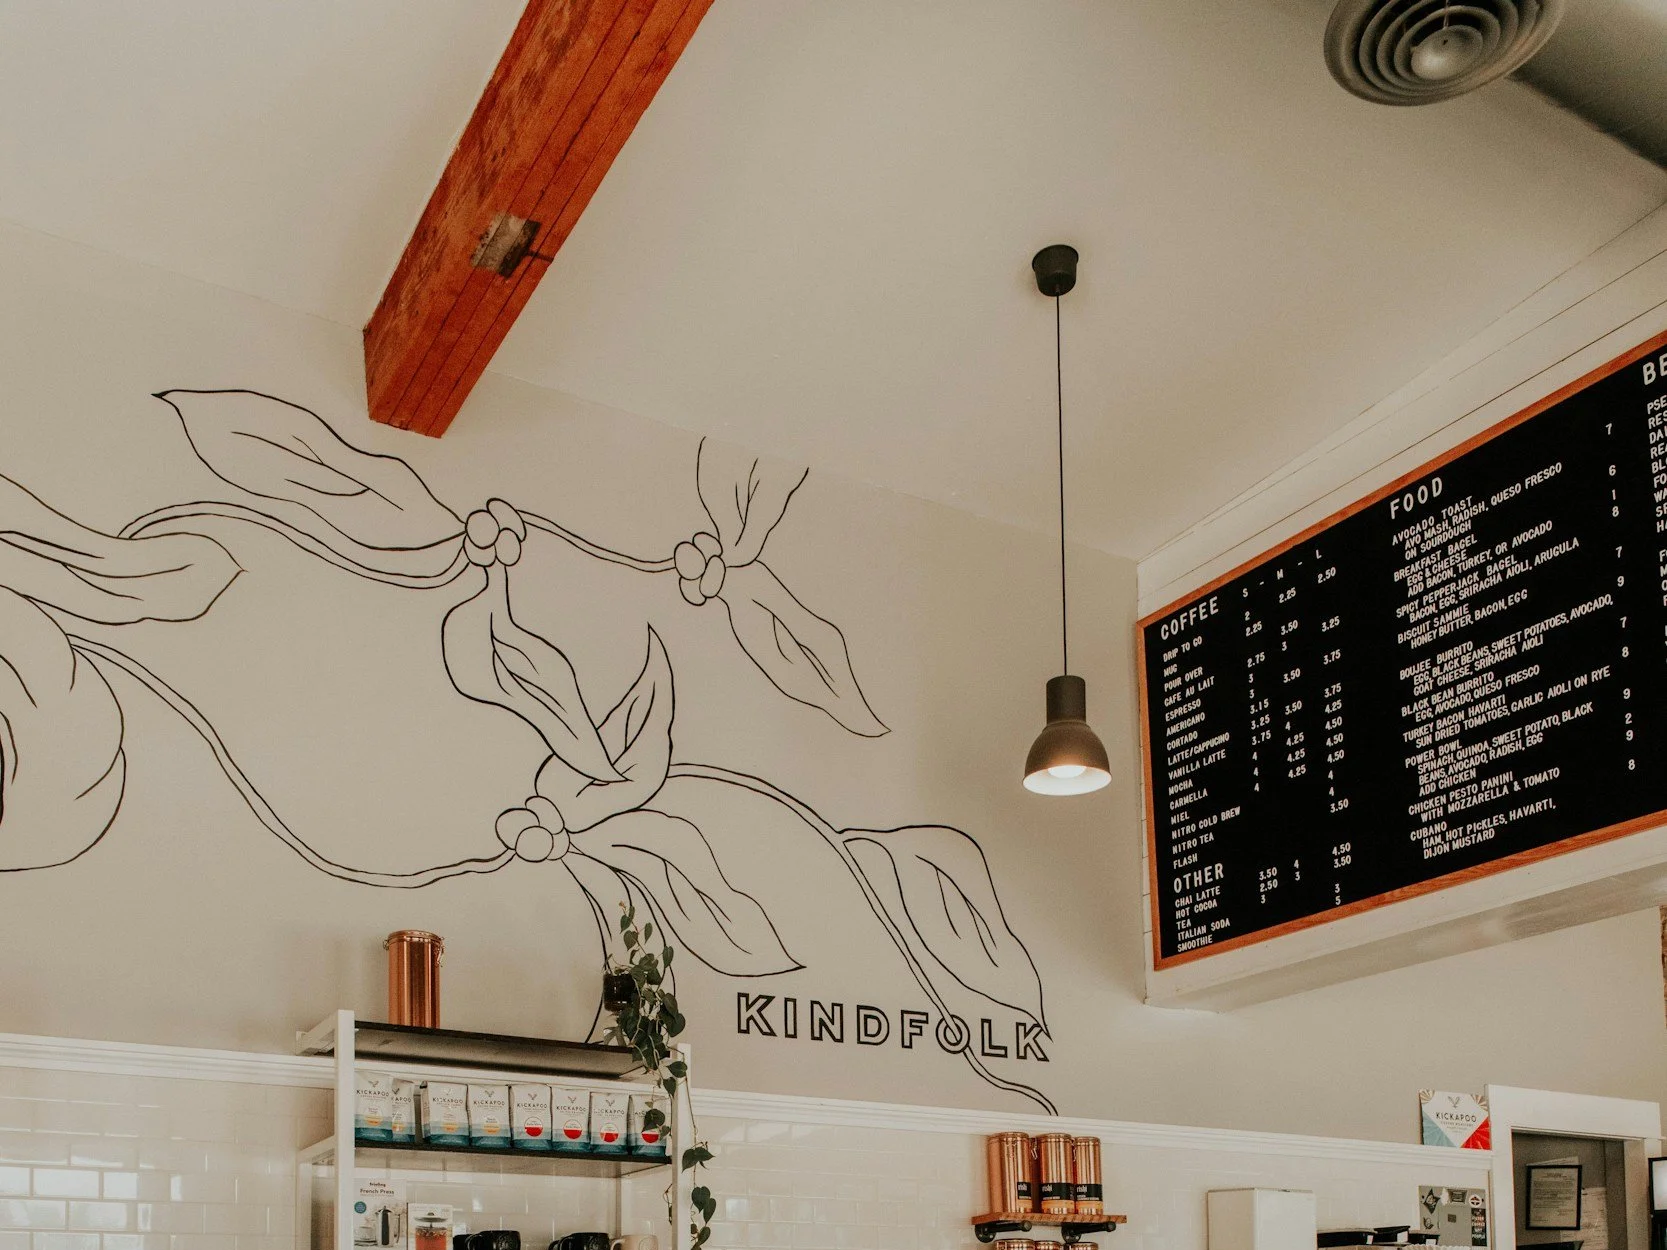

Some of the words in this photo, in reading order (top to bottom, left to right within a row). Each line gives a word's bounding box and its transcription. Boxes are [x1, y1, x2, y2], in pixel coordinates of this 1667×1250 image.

[1390, 476, 1443, 520] FOOD
[1392, 515, 1435, 546] AVOCADO
[1441, 495, 1473, 520] TOAST
[1404, 533, 1422, 551] AVO
[1423, 519, 1452, 541] MASH,
[1451, 500, 1489, 527] RADISH,
[1490, 482, 1522, 506] QUESO
[1525, 462, 1562, 490] FRESCO
[1393, 549, 1442, 582] BREAKFAST
[1447, 533, 1478, 556] BAGEL
[1405, 546, 1417, 561] ON
[1420, 519, 1472, 553] SOURDOUGH
[1407, 581, 1425, 598] ADD
[1426, 567, 1457, 589] BACON,
[1456, 548, 1493, 574] TURKEY,
[1495, 541, 1508, 556] OR
[1511, 520, 1553, 549] AVOCADO
[1242, 588, 1249, 598] S
[1276, 568, 1284, 580] M
[1315, 549, 1322, 560] L
[1396, 599, 1419, 619] SPICY
[1422, 571, 1480, 606] PEPPERJACK
[1486, 554, 1518, 577] BAGEL
[1407, 570, 1424, 587] EGG
[1424, 567, 1432, 578] &
[1431, 548, 1468, 575] CHEESE
[1409, 602, 1438, 624] BACON,
[1438, 593, 1459, 610] EGG,
[1458, 572, 1503, 600] SRIRACHA
[1506, 559, 1533, 579] AIOLI,
[1534, 537, 1580, 567] ARUGULA
[1160, 595, 1219, 641] COFFEE
[1163, 647, 1179, 663] DRIP
[1181, 641, 1191, 653] TO
[1192, 635, 1203, 647] GO
[1278, 587, 1297, 604] 2.25
[1317, 566, 1336, 584] 2.50
[1397, 620, 1431, 644] BISCUIT
[1433, 603, 1470, 628] SAMMIE
[1163, 663, 1178, 678] MUG
[1245, 620, 1263, 637] 2.25
[1164, 676, 1182, 693] POUR
[1184, 666, 1203, 682] OVER
[1280, 619, 1299, 636] 3.50
[1164, 691, 1182, 707] CAFE
[1185, 685, 1195, 698] AU
[1197, 675, 1215, 692] LAIT
[1247, 651, 1266, 668] 2.75
[1321, 615, 1340, 632] 3.25
[1399, 658, 1432, 681] BOUJEE
[1436, 640, 1474, 665] BURRITO
[1413, 679, 1435, 697] GOAT
[1436, 664, 1473, 687] CHEESE,
[1474, 645, 1518, 672] SRIRACHA
[1521, 634, 1544, 653] AIOLI
[1165, 698, 1201, 722] ESPRESSO
[1166, 711, 1206, 737] AMERICANO
[1283, 667, 1301, 684] 3.50
[1323, 648, 1341, 665] 3.75
[1251, 713, 1271, 730] 3.25
[1285, 700, 1303, 715] 3.50
[1324, 682, 1342, 698] 3.75
[1401, 697, 1430, 717] BLACK
[1431, 686, 1454, 705] BEAN
[1456, 671, 1495, 695] BURRITO
[1415, 733, 1433, 749] SUN
[1434, 723, 1461, 742] DRIED
[1462, 705, 1511, 731] TOMATOES,
[1510, 691, 1544, 713] GARLIC
[1547, 680, 1572, 699] AIOLI
[1573, 674, 1588, 689] ON
[1591, 665, 1611, 683] RYE
[1166, 730, 1198, 751] CORTADO
[1249, 698, 1269, 715] 3.15
[1168, 760, 1201, 781] VANILLA
[1202, 748, 1226, 767] LATTE
[1252, 729, 1272, 746] 3.75
[1324, 699, 1342, 714] 4.25
[1402, 722, 1434, 743] TURKEY
[1436, 710, 1465, 730] BACON
[1468, 694, 1506, 718] HAVARTI
[1168, 778, 1194, 796] MOCHA
[1286, 731, 1305, 747] 4.25
[1325, 716, 1343, 731] 4.50
[1169, 788, 1208, 811] CARMELLA
[1287, 747, 1306, 763] 4.25
[1326, 732, 1344, 747] 4.50
[1405, 749, 1436, 769] POWER
[1438, 739, 1463, 757] BOWL
[1170, 811, 1190, 825] MIEL
[1288, 764, 1307, 779] 4.25
[1327, 749, 1345, 764] 4.50
[1408, 794, 1447, 816] CHICKEN
[1449, 783, 1478, 802] PESTO
[1481, 771, 1514, 791] PANINI
[1419, 782, 1437, 797] ADD
[1438, 767, 1477, 790] CHICKEN
[1420, 806, 1444, 823] WITH
[1447, 784, 1509, 814] MOZZARELLA
[1513, 780, 1521, 792] &
[1522, 767, 1560, 789] TOMATO
[1171, 823, 1196, 840] NITRO
[1198, 814, 1218, 830] COLD
[1220, 805, 1241, 822] BREW
[1172, 838, 1198, 855] NITRO
[1199, 832, 1214, 845] TEA
[1173, 852, 1198, 870] FLASH
[1330, 798, 1349, 813] 3.50
[1410, 820, 1448, 842] CUBANO
[1423, 842, 1450, 860] DIJON
[1451, 828, 1495, 851] MUSTARD
[1173, 862, 1224, 894] OTHER
[1174, 894, 1193, 908] CHAI
[1196, 885, 1221, 902] LATTE
[1259, 866, 1278, 881] 3.50
[1332, 842, 1351, 856] 4.50
[1175, 906, 1190, 920] HOT
[1193, 898, 1218, 914] COCOA
[1259, 878, 1278, 893] 2.50
[1333, 854, 1352, 869] 3.50
[1176, 918, 1192, 930] TEA
[1177, 924, 1207, 941] ITALIAN
[1210, 917, 1231, 932] SODA
[1177, 934, 1213, 953] SMOOTHIE
[737, 992, 1050, 1062] KINDFOLK
[1435, 1111, 1478, 1123] KICKAPOO
